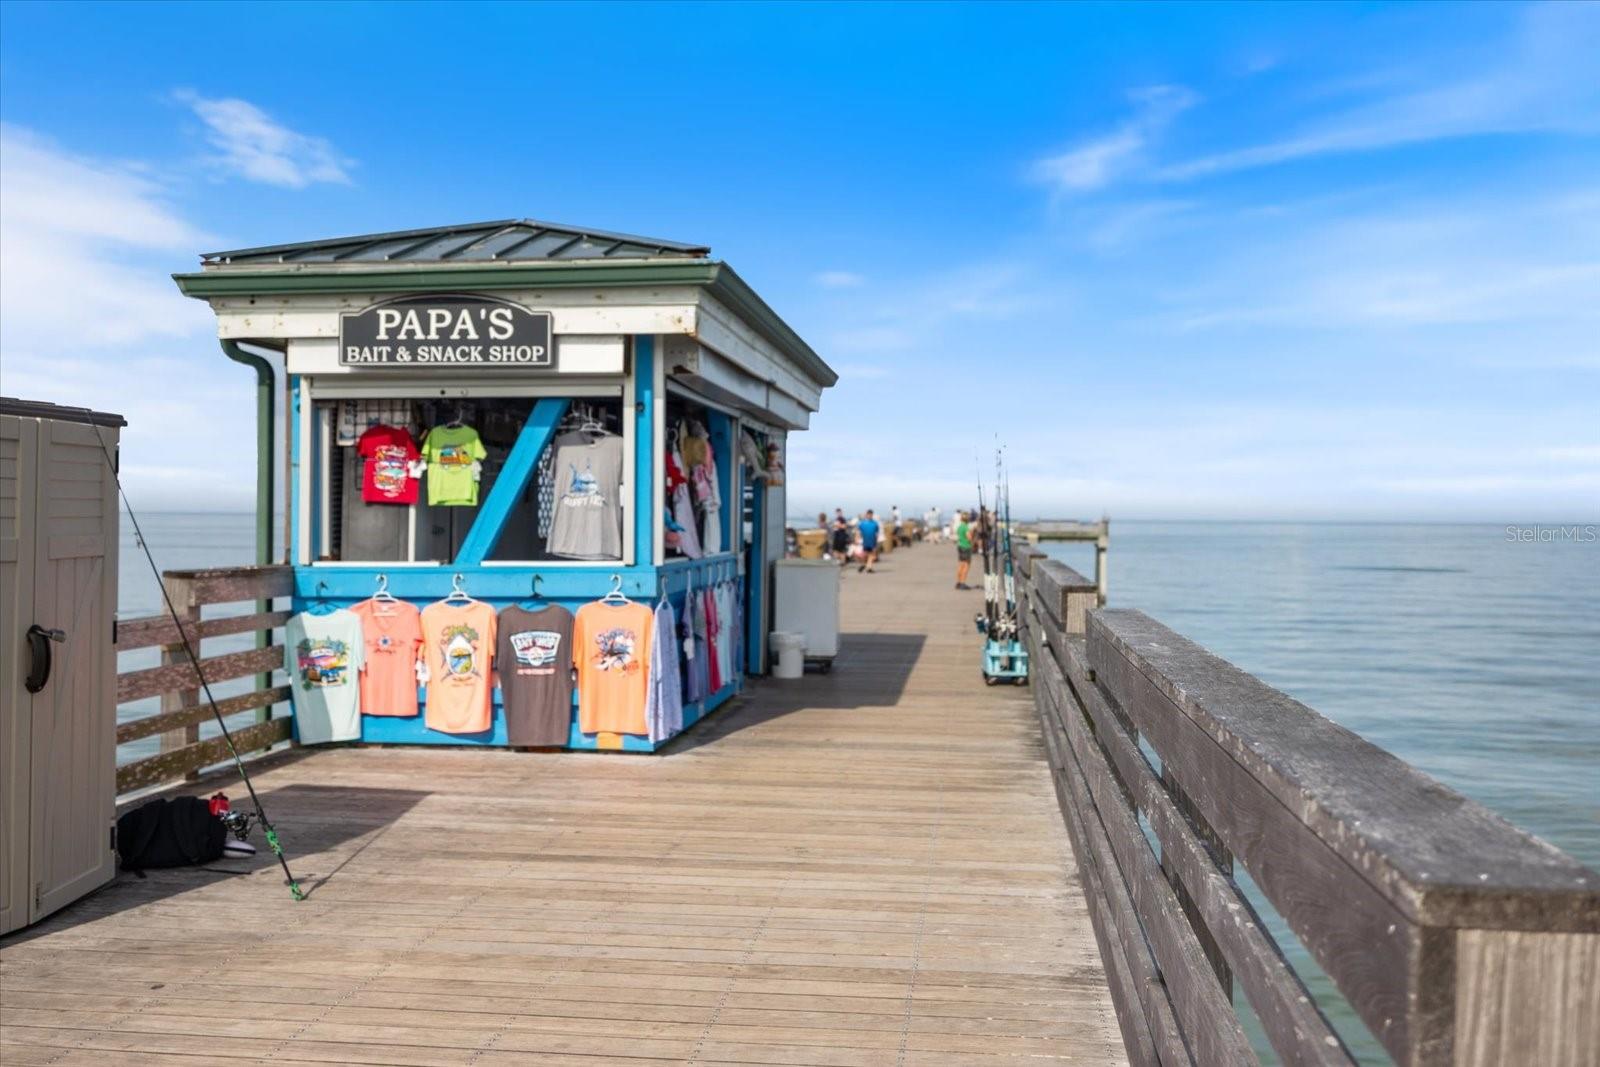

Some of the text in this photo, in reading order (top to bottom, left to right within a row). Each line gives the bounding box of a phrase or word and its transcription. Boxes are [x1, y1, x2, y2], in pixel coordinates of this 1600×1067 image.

[375, 308, 514, 340] PAPA'S
[346, 345, 544, 362] BAIT & SNACK SHOP
